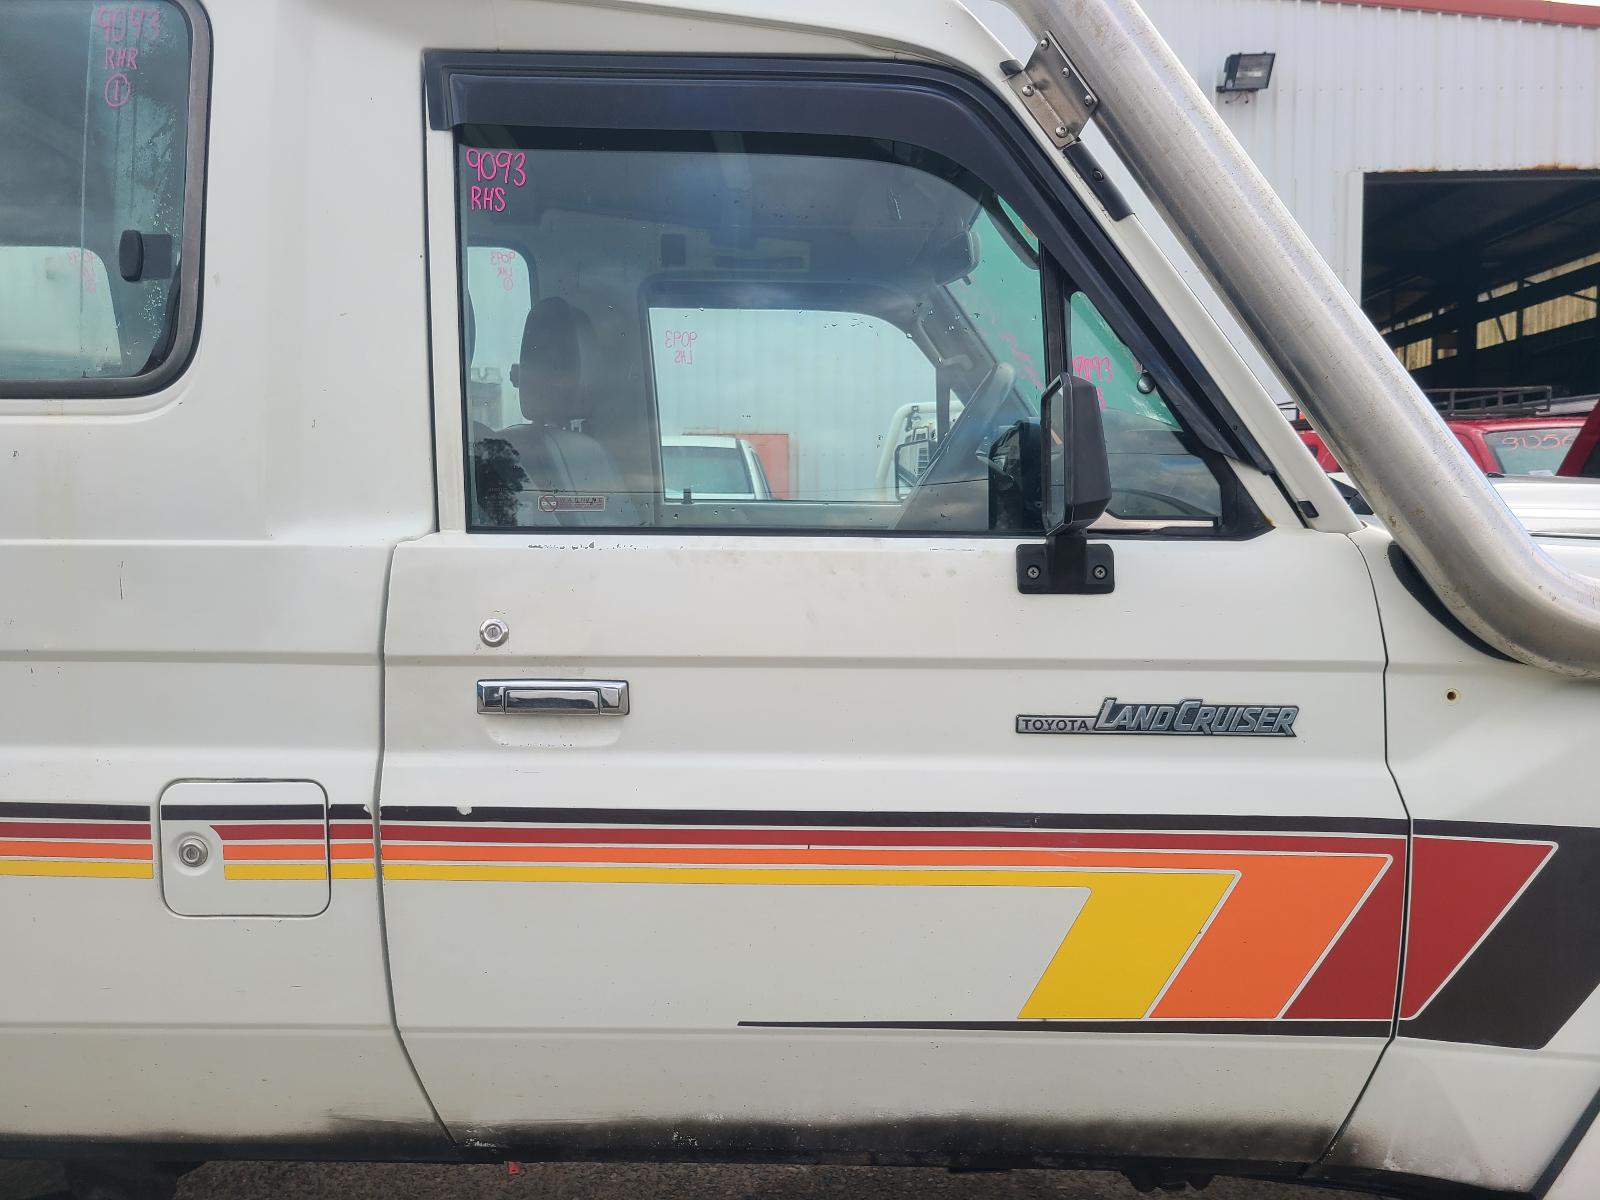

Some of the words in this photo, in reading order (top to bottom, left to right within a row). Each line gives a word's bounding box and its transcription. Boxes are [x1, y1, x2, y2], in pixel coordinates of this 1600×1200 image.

[96, 5, 161, 44] 9093
[105, 47, 138, 70] RHR
[466, 148, 526, 187] 9093
[471, 185, 506, 212] RHS
[1072, 354, 1113, 384] 9093
[1021, 718, 1089, 732] TOYOTA
